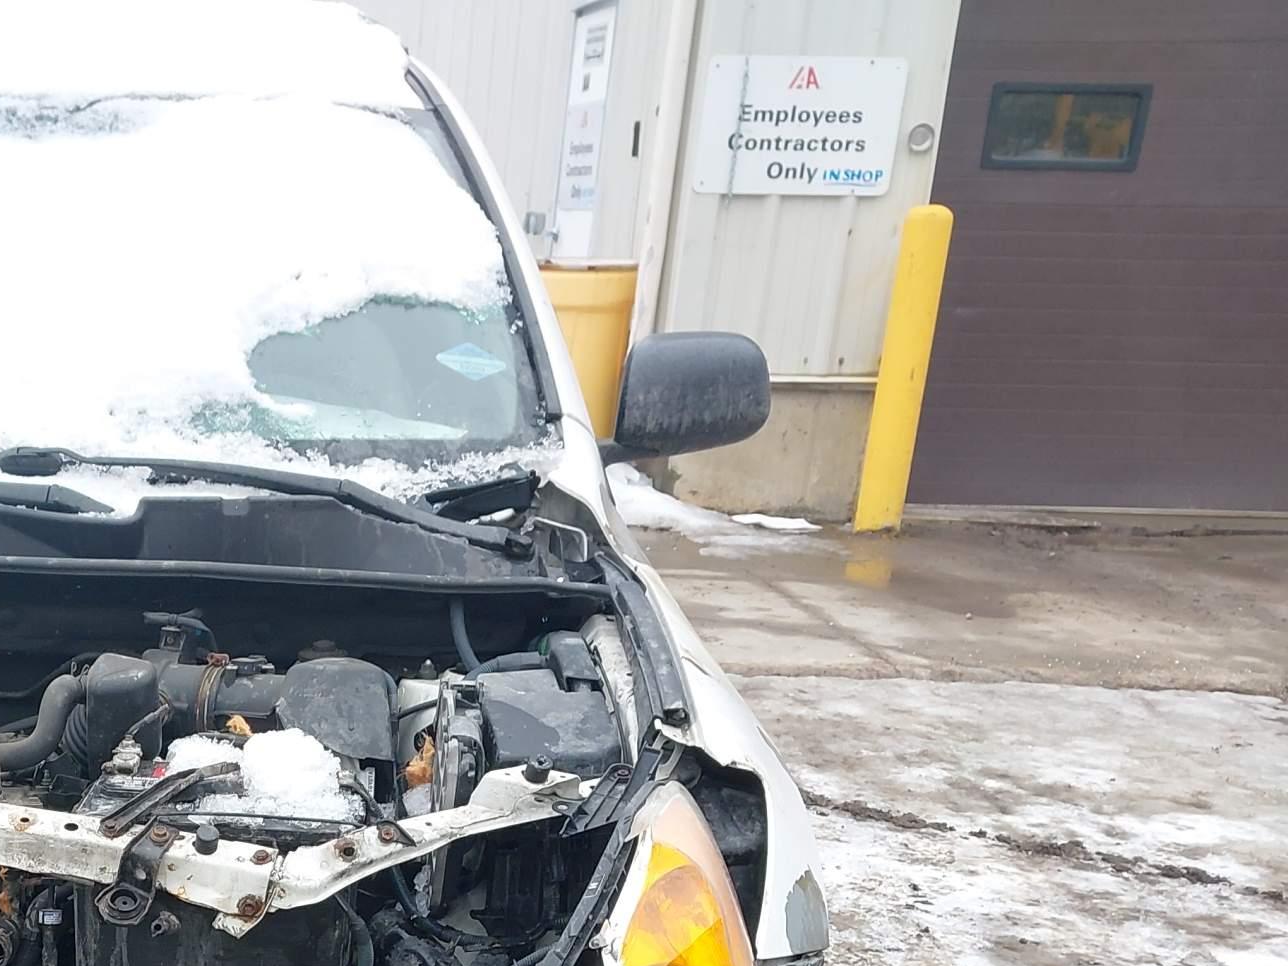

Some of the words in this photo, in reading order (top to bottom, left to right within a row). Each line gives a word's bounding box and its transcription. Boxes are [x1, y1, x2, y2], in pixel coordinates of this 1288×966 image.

[739, 103, 864, 128] Employees
[727, 131, 867, 152] Contractors
[766, 161, 818, 184] Only
